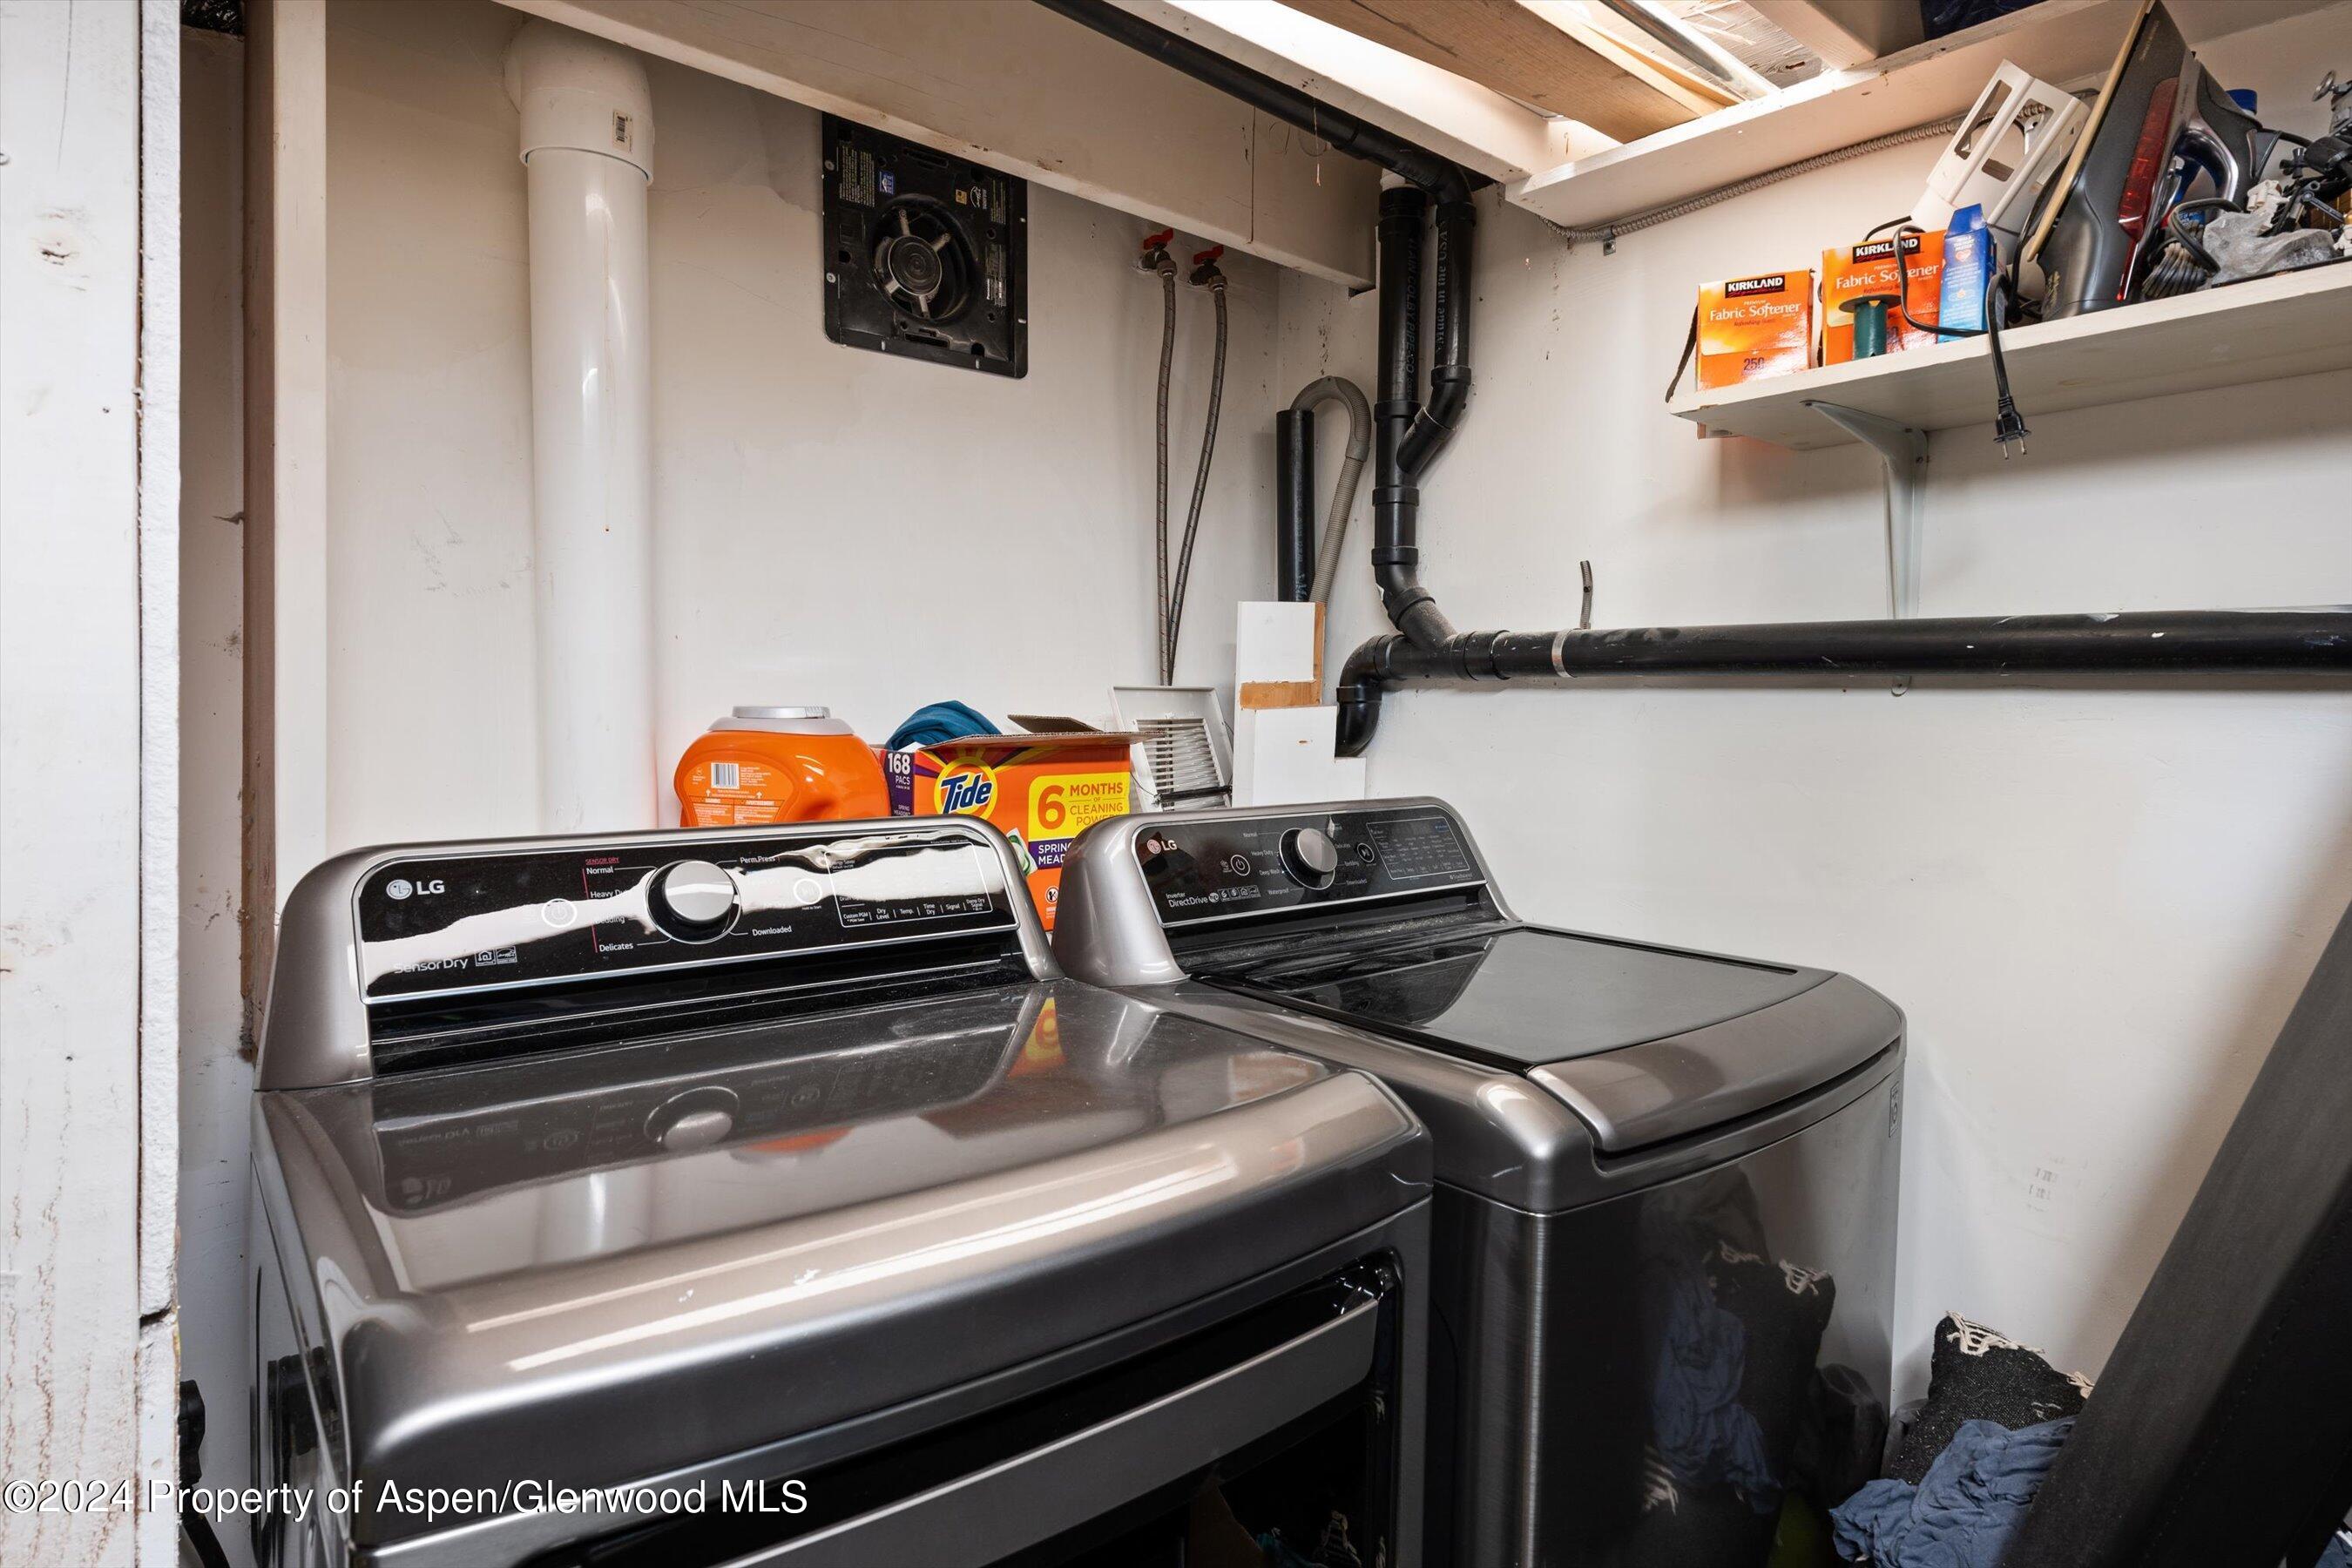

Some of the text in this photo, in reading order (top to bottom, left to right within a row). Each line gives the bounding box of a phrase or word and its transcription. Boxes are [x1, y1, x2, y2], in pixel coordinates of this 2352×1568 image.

[1856, 239, 1918, 257] KIRKLND
[1728, 278, 1783, 292] KIRKLAND
[1836, 274, 1876, 289] Fabric
[1710, 302, 1801, 321] Fabric Softener
[888, 753, 910, 774] 168
[896, 776, 910, 785] PACS
[941, 771, 992, 814] Tide
[1037, 782, 1123, 829] 6 MONTHS
[1070, 802, 1124, 815] CLEANING
[1160, 840, 1177, 851] LG
[416, 880, 445, 896] LG
[1169, 896, 1208, 907] DirectDrive
[753, 925, 793, 936] Downloaded
[599, 943, 633, 952] Delicates
